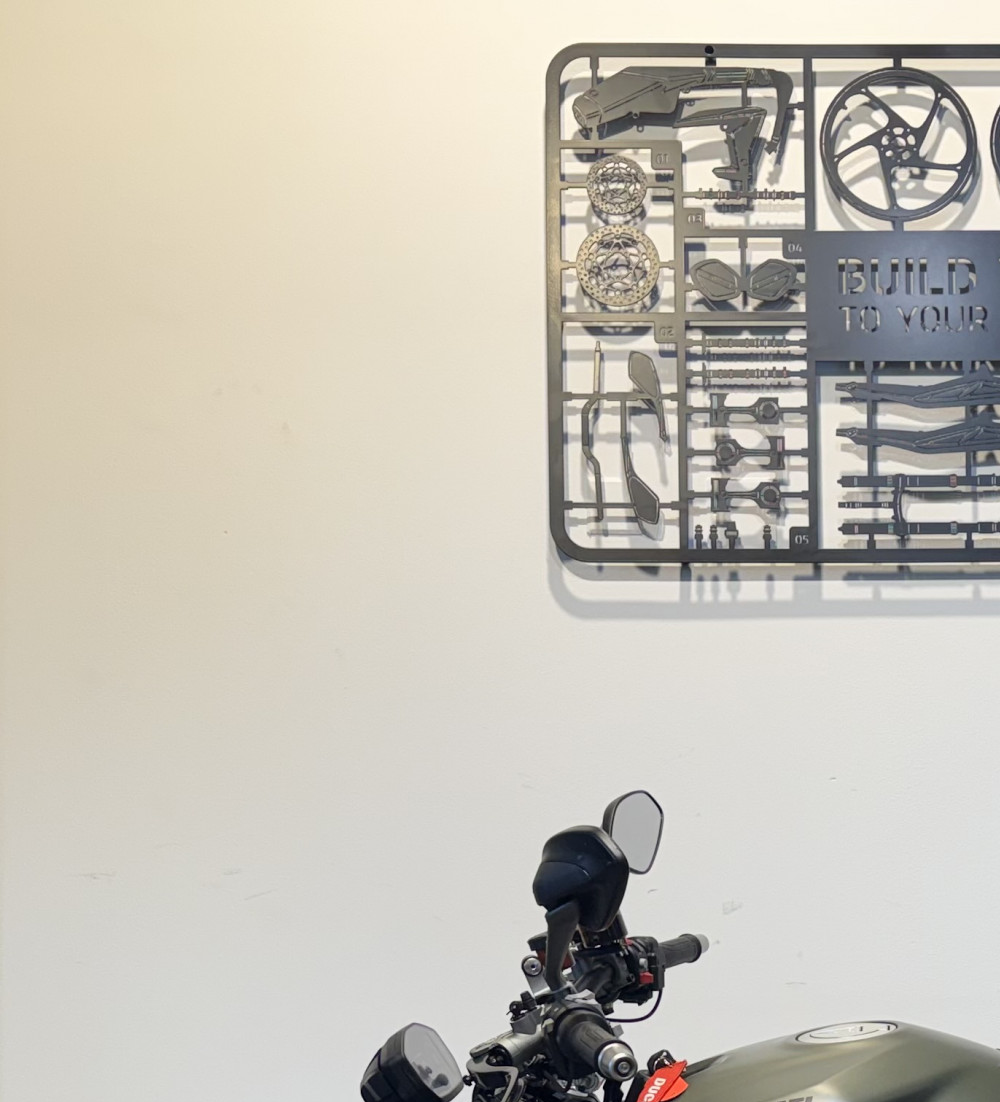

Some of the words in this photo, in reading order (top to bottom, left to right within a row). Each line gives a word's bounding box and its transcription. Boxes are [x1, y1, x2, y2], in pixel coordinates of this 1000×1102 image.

[687, 213, 703, 223] 03
[787, 243, 803, 253] 04
[837, 257, 977, 296] BUILD
[838, 305, 882, 333] TO
[896, 305, 988, 333] YOUR
[794, 534, 809, 545] 05
